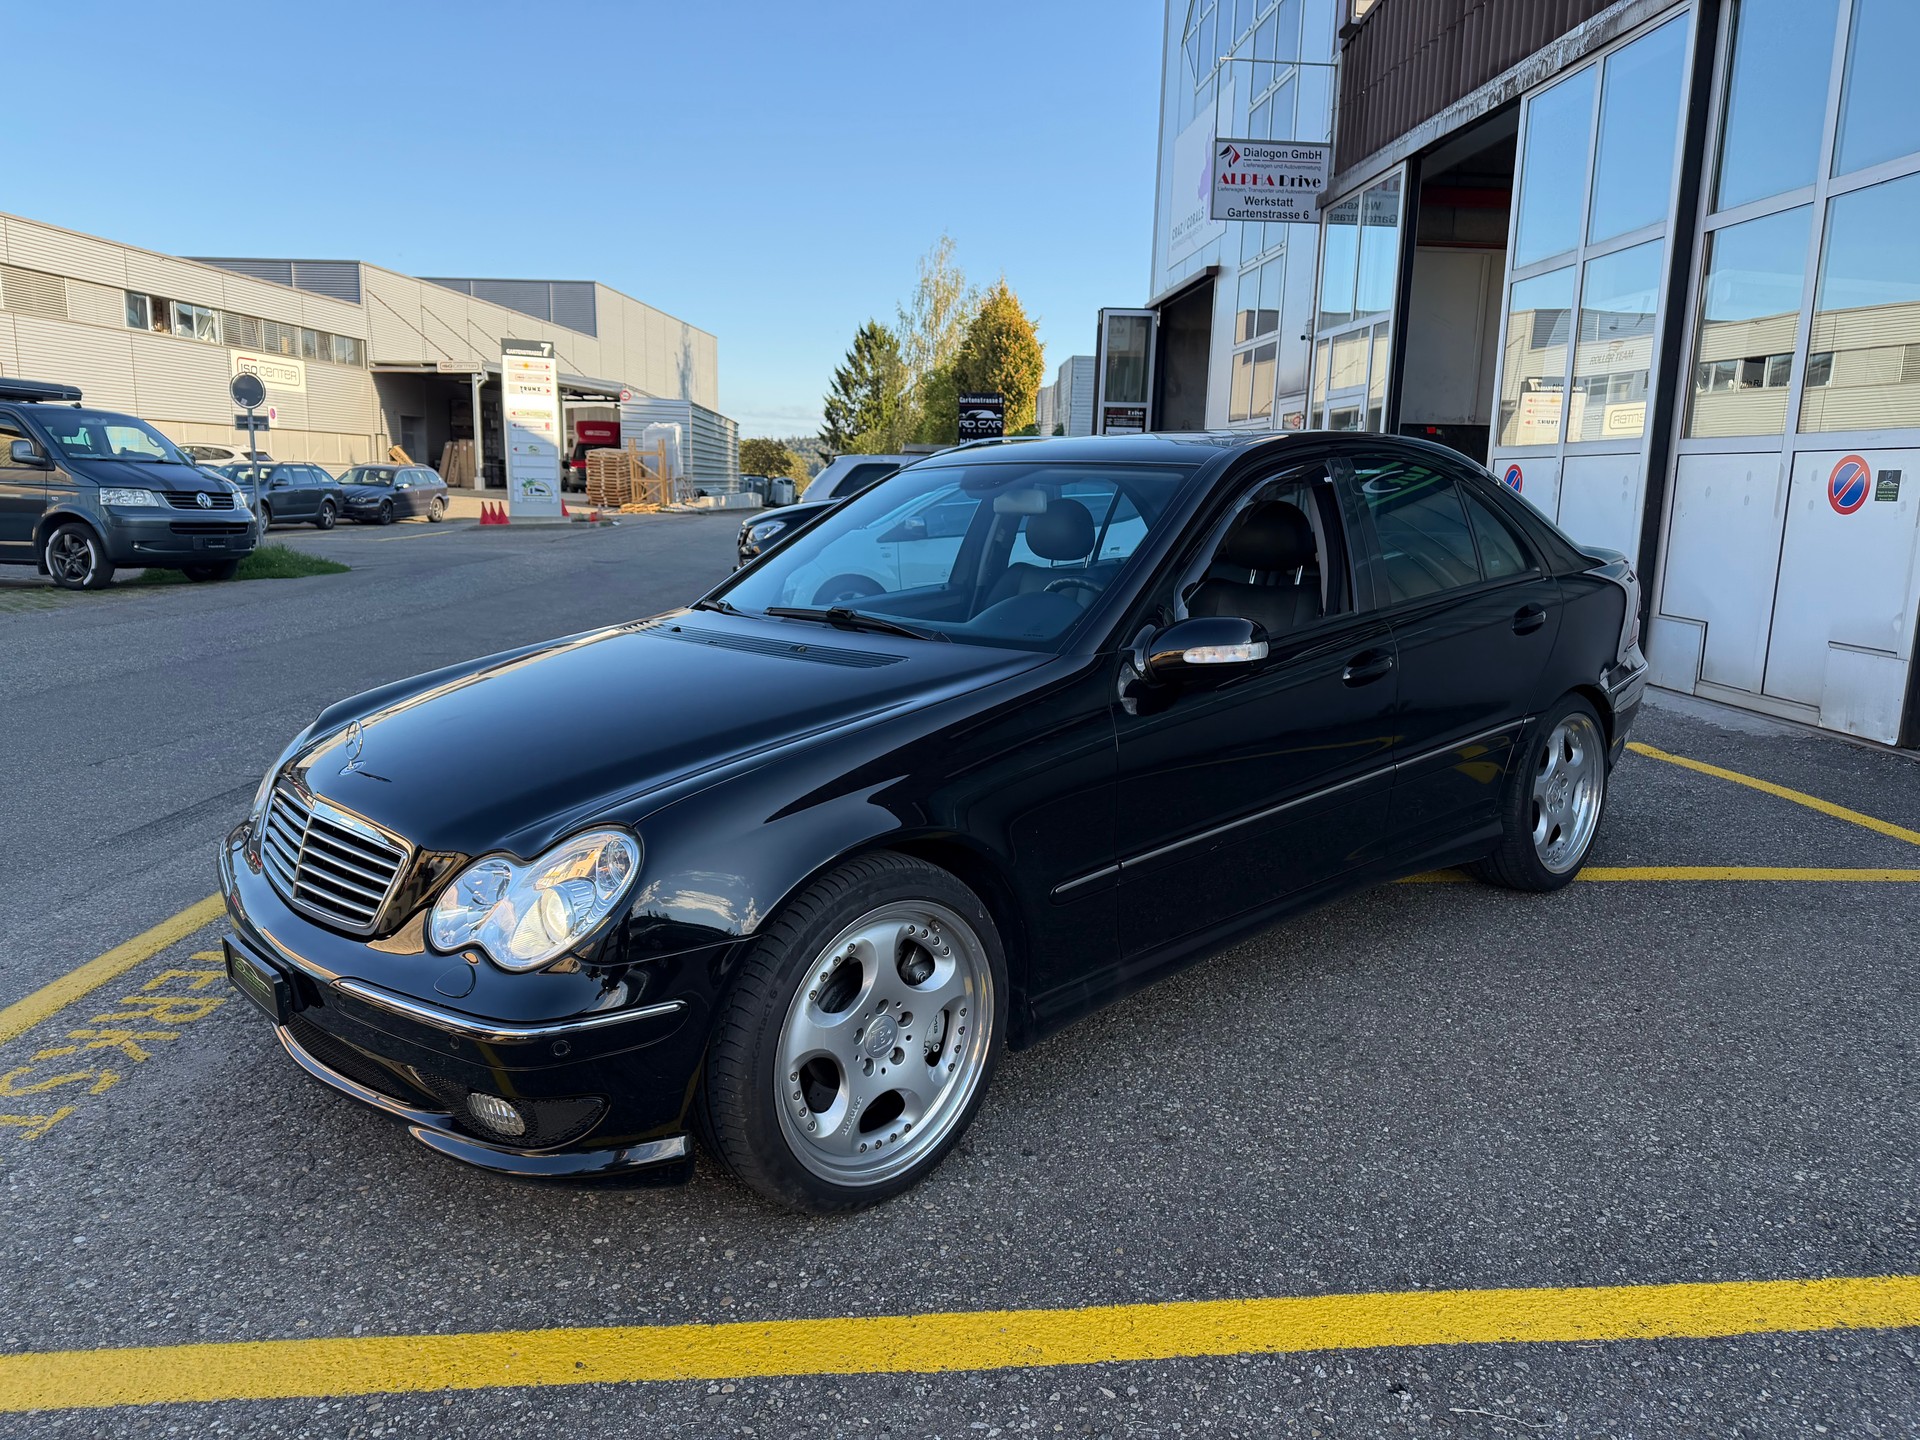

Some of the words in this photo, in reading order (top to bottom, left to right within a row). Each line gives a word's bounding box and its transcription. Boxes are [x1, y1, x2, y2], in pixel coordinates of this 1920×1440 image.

[1244, 148, 1288, 160] Dialogon
[1291, 149, 1322, 160] GmbH
[1217, 172, 1275, 186] ALPHA
[1279, 175, 1321, 188] Drive
[1244, 195, 1294, 207] Werkstatt
[1227, 207, 1300, 219] Gartenstrasse
[1303, 210, 1309, 219] 6
[540, 342, 552, 357] 7
[977, 420, 1003, 428] CAR
